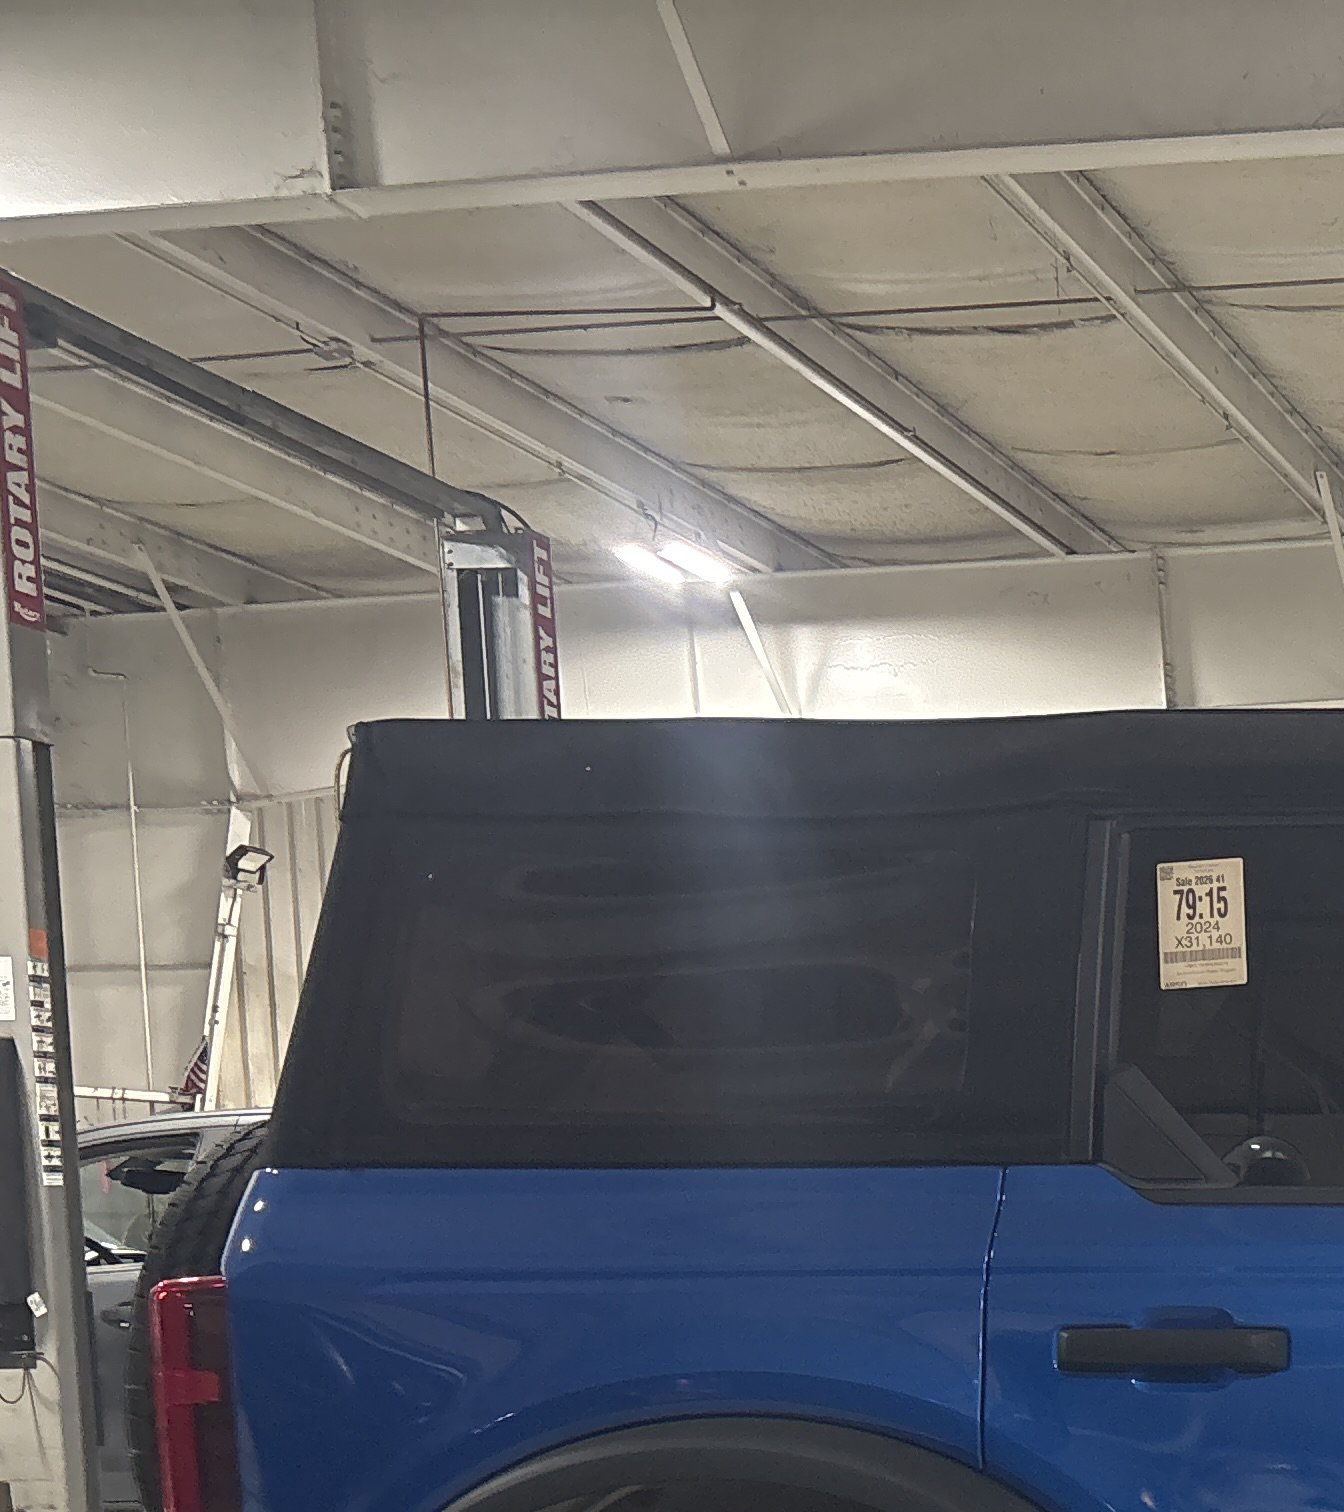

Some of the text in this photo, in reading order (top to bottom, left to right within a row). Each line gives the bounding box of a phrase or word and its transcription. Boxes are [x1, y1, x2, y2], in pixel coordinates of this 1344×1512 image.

[0, 398, 38, 597] ROTARY
[533, 540, 559, 720] TARY LIFT
[1176, 876, 1193, 887] Sale
[1173, 886, 1229, 920] 79:15
[1185, 920, 1220, 934] 2024
[1174, 933, 1233, 949] X31,140
